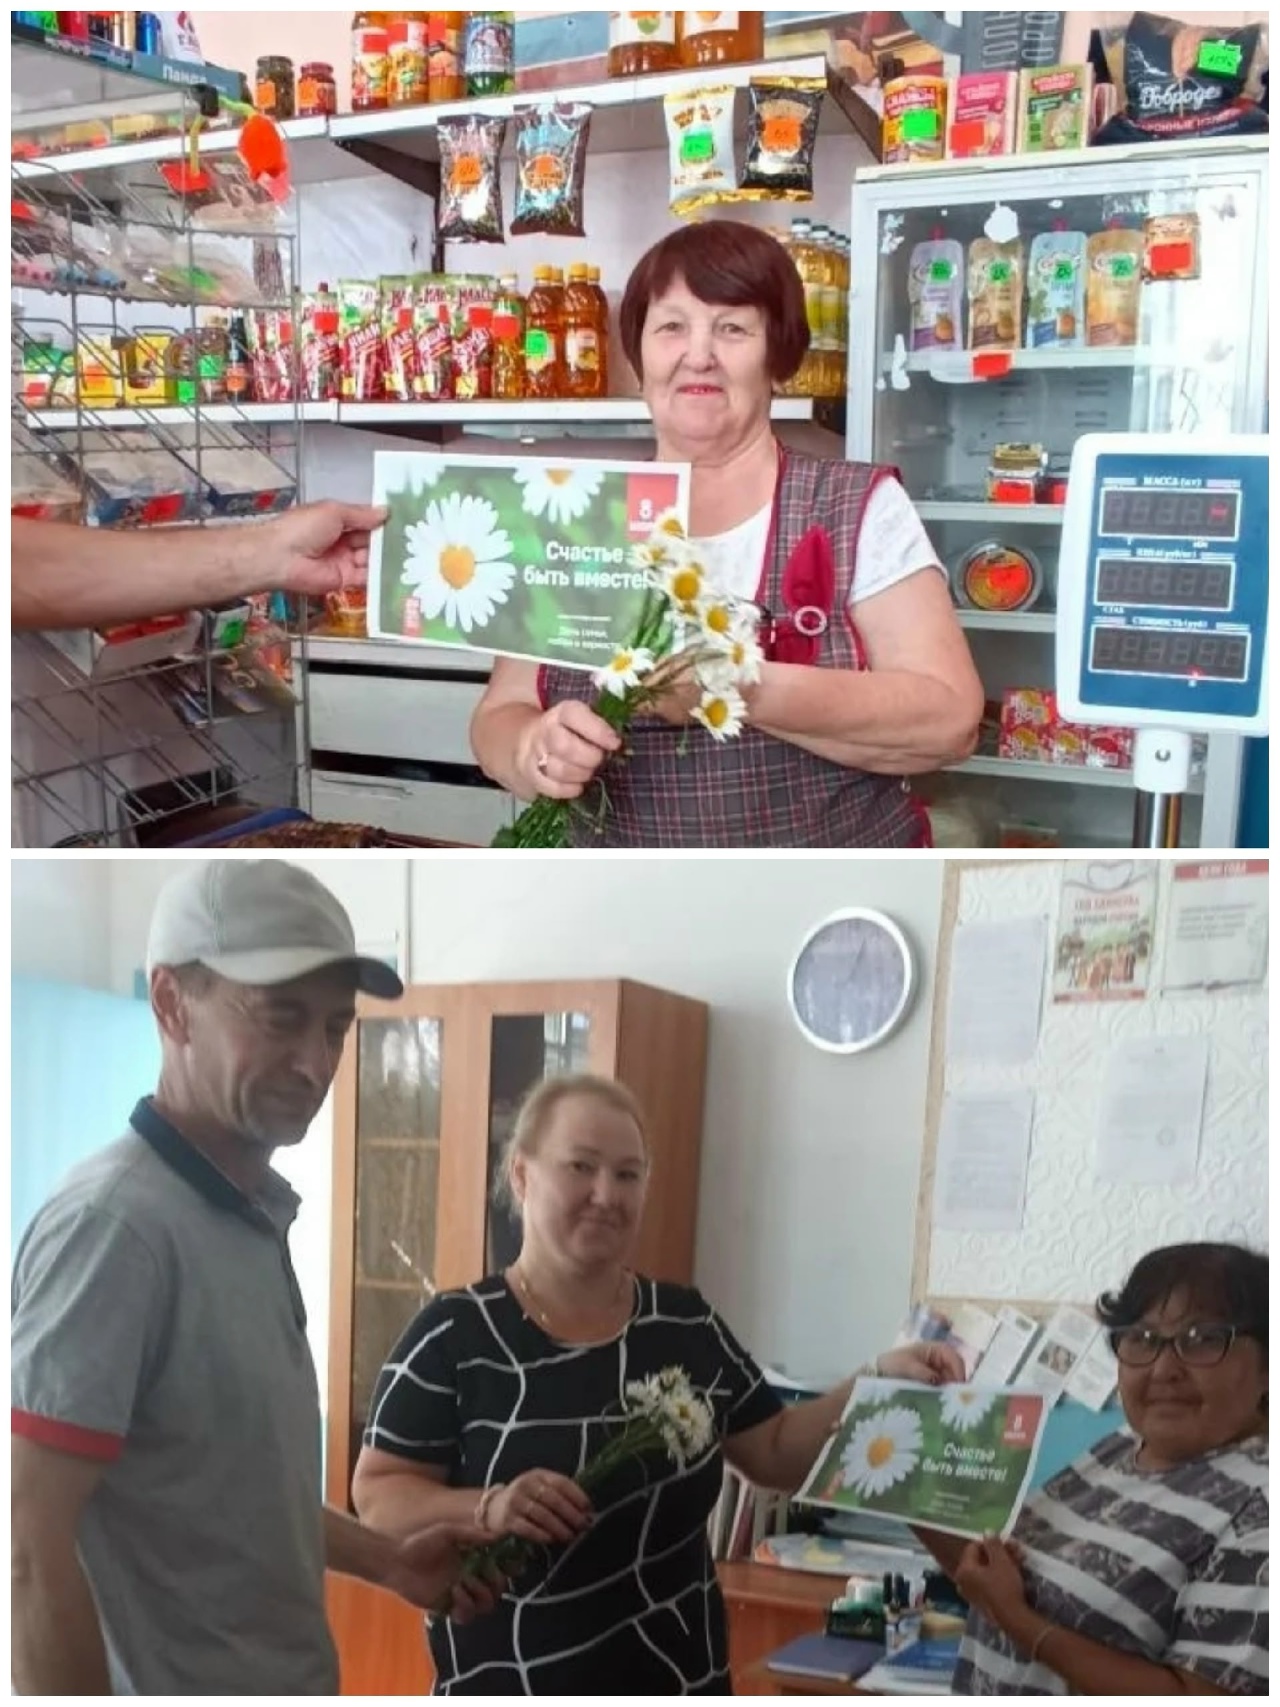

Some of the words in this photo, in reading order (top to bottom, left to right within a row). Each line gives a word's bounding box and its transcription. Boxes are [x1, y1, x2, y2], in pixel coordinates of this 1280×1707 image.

[638, 498, 653, 520] 8
[546, 540, 624, 564] Счастье
[523, 564, 570, 587] быть
[573, 570, 649, 590] вместе!
[943, 1442, 996, 1463] Счастье
[922, 1456, 953, 1477] быть
[955, 1463, 1009, 1483] вместе!
